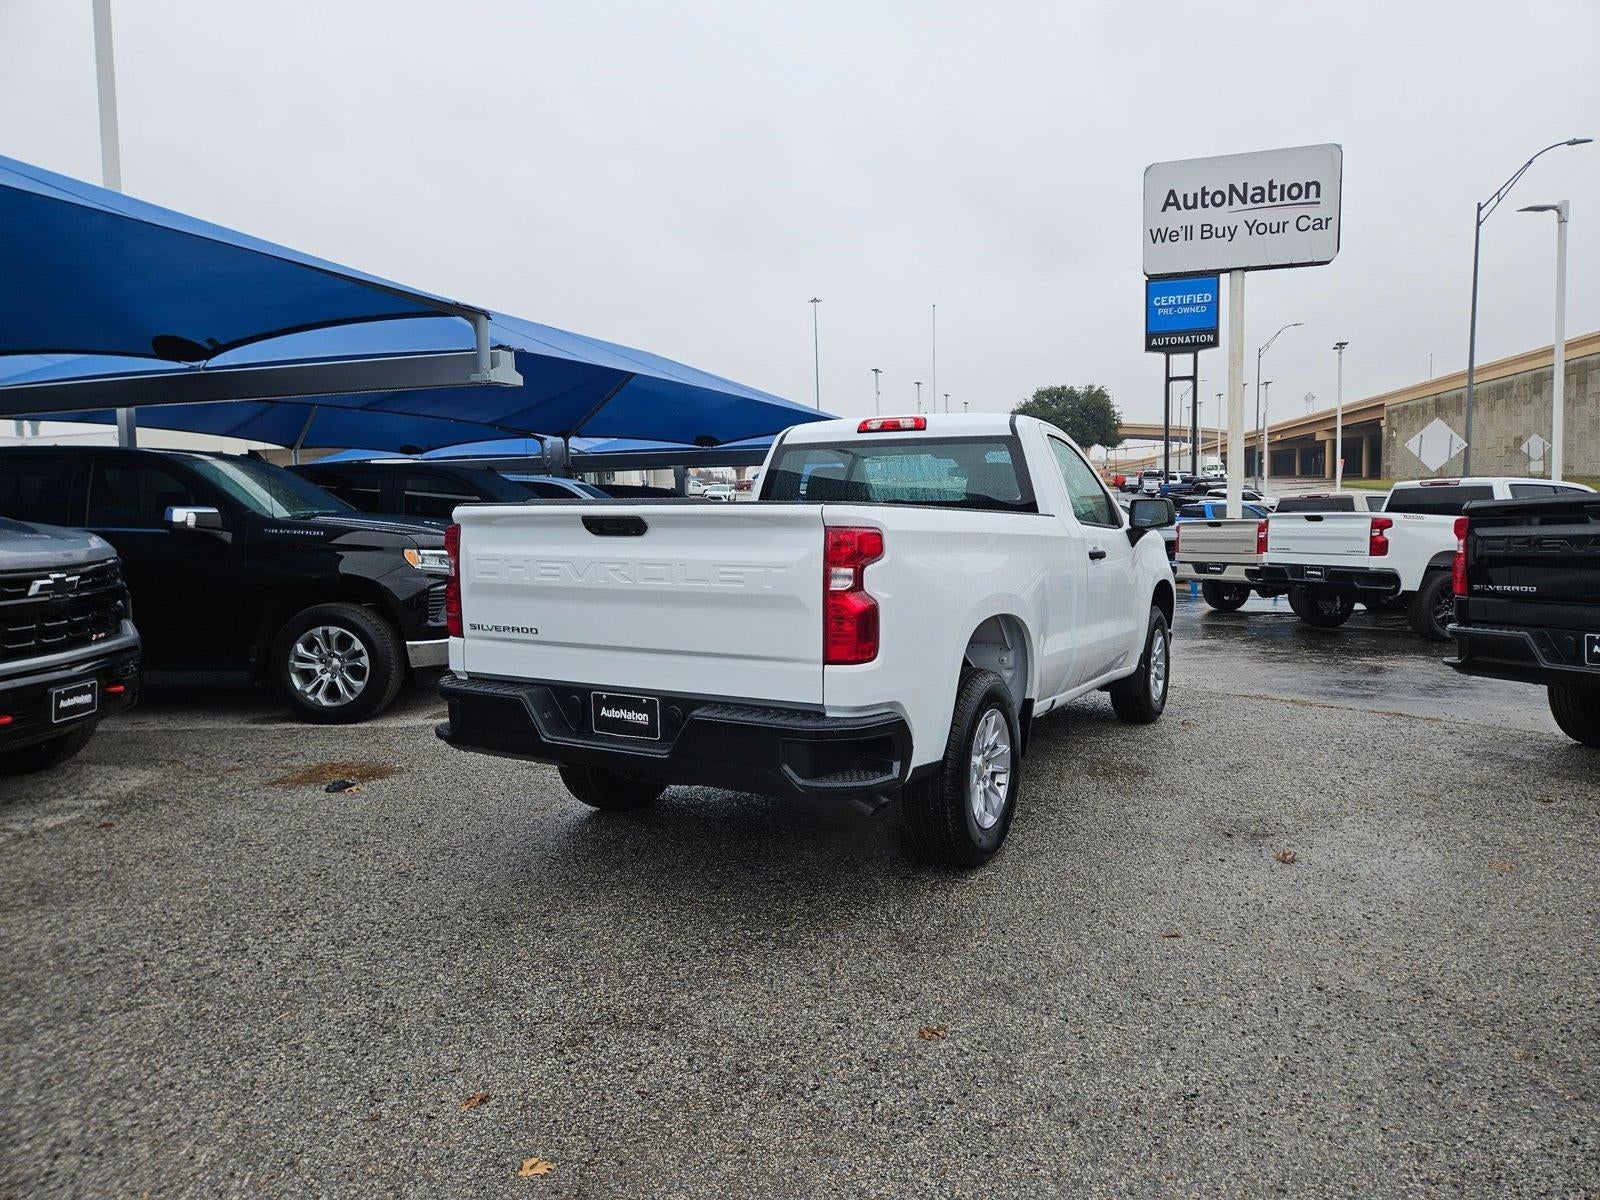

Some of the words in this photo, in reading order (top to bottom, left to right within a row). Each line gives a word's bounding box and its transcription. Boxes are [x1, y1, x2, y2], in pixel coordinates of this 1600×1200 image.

[1161, 179, 1321, 212] AutoNation
[1150, 225, 1193, 244] We'll
[1200, 223, 1238, 242] Buy
[1244, 218, 1289, 236] Your
[1295, 215, 1332, 232] Car
[1153, 293, 1212, 306] CERTIFIED
[1157, 305, 1207, 315] PRE-OWNED
[1151, 334, 1214, 346] AUTONATION
[264, 528, 324, 537] SILVERADO
[475, 558, 788, 589] CHEVROLET
[1472, 584, 1537, 593] SILVERADO
[469, 622, 539, 635] SILVERADO
[59, 693, 93, 709] AutoNation
[600, 706, 650, 722] AutoNation
